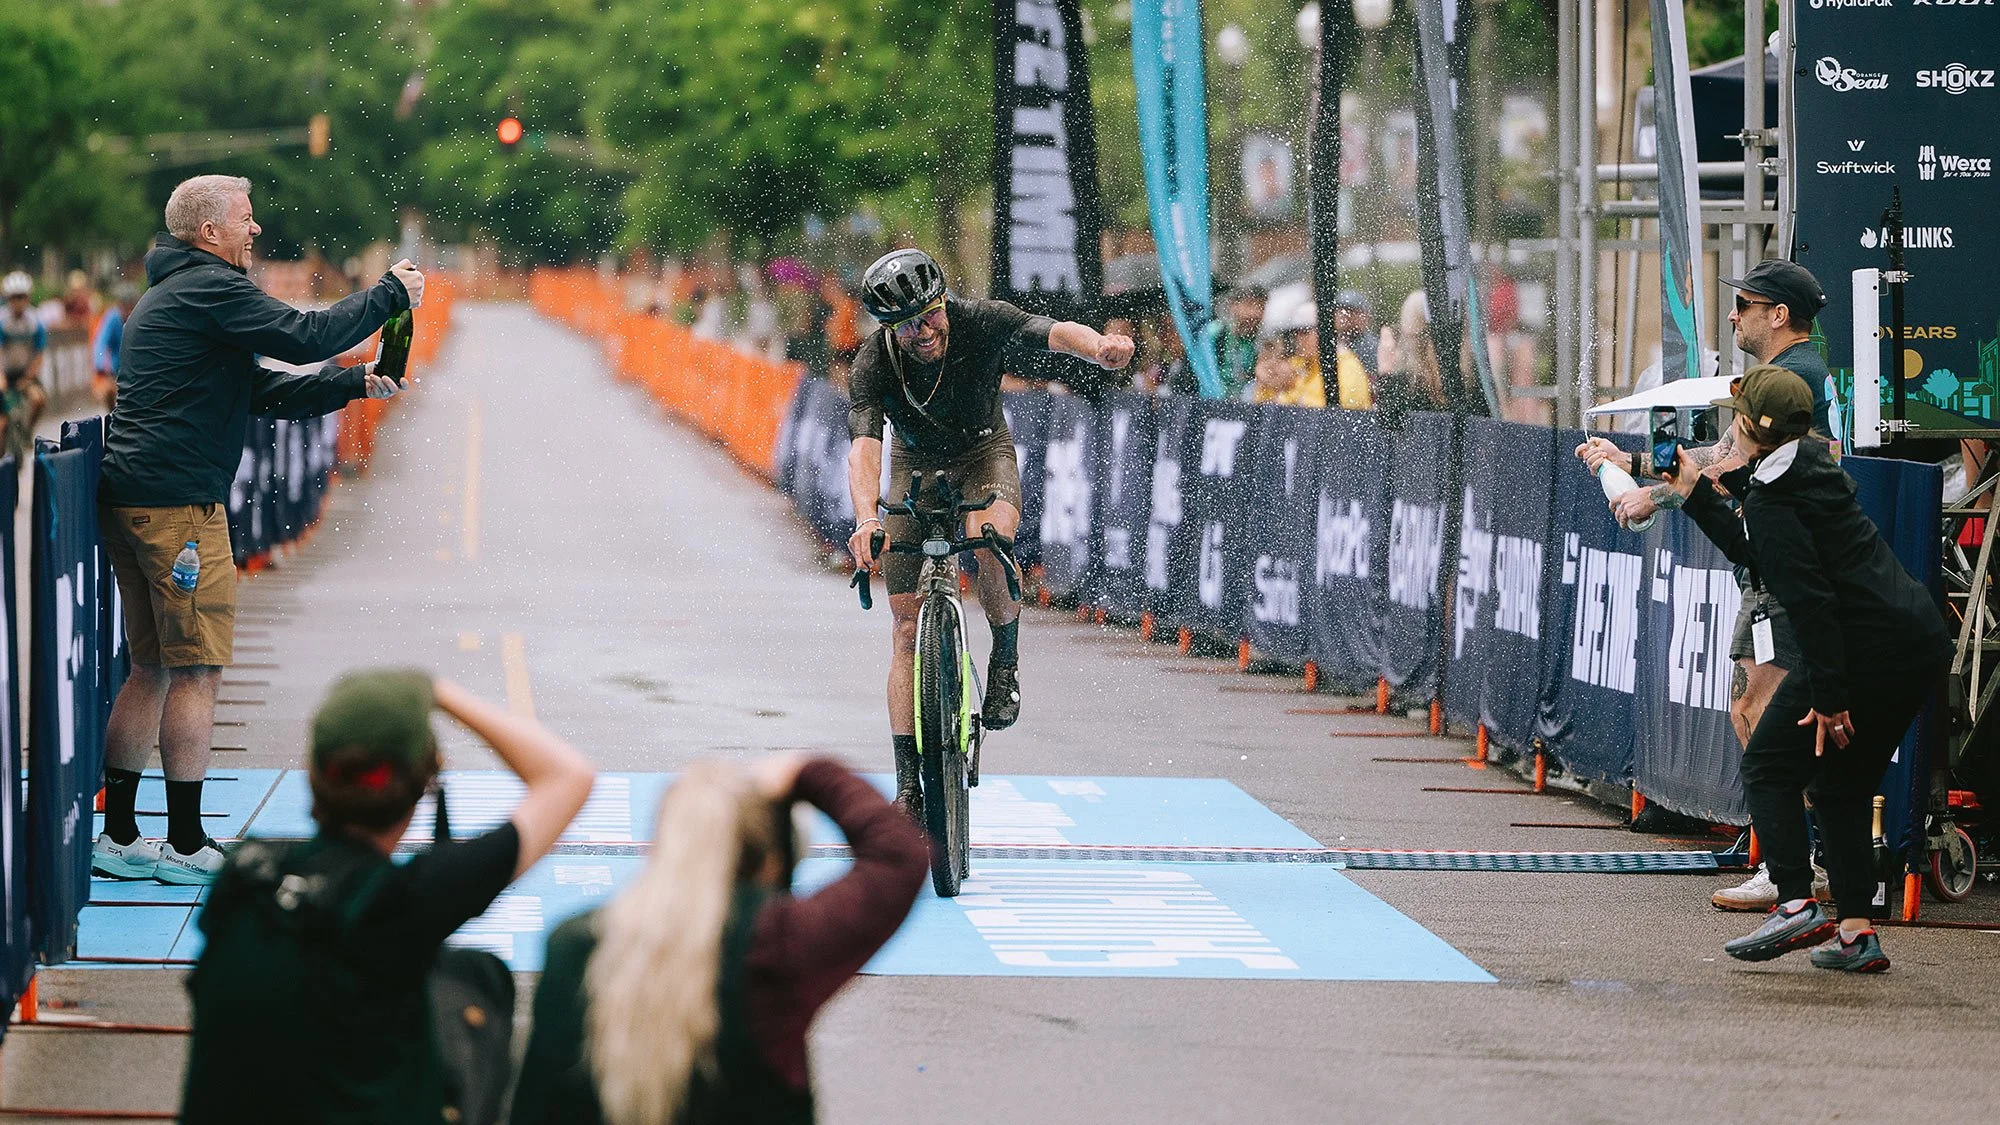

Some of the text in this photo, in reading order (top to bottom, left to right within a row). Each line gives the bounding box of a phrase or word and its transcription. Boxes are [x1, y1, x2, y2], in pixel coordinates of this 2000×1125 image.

[1832, 69, 1889, 92] Seal
[1916, 69, 1995, 88] SHOKZ
[1816, 161, 1896, 175] Swiftwick
[1939, 155, 1991, 171] Wera
[165, 854, 184, 866] Mount
